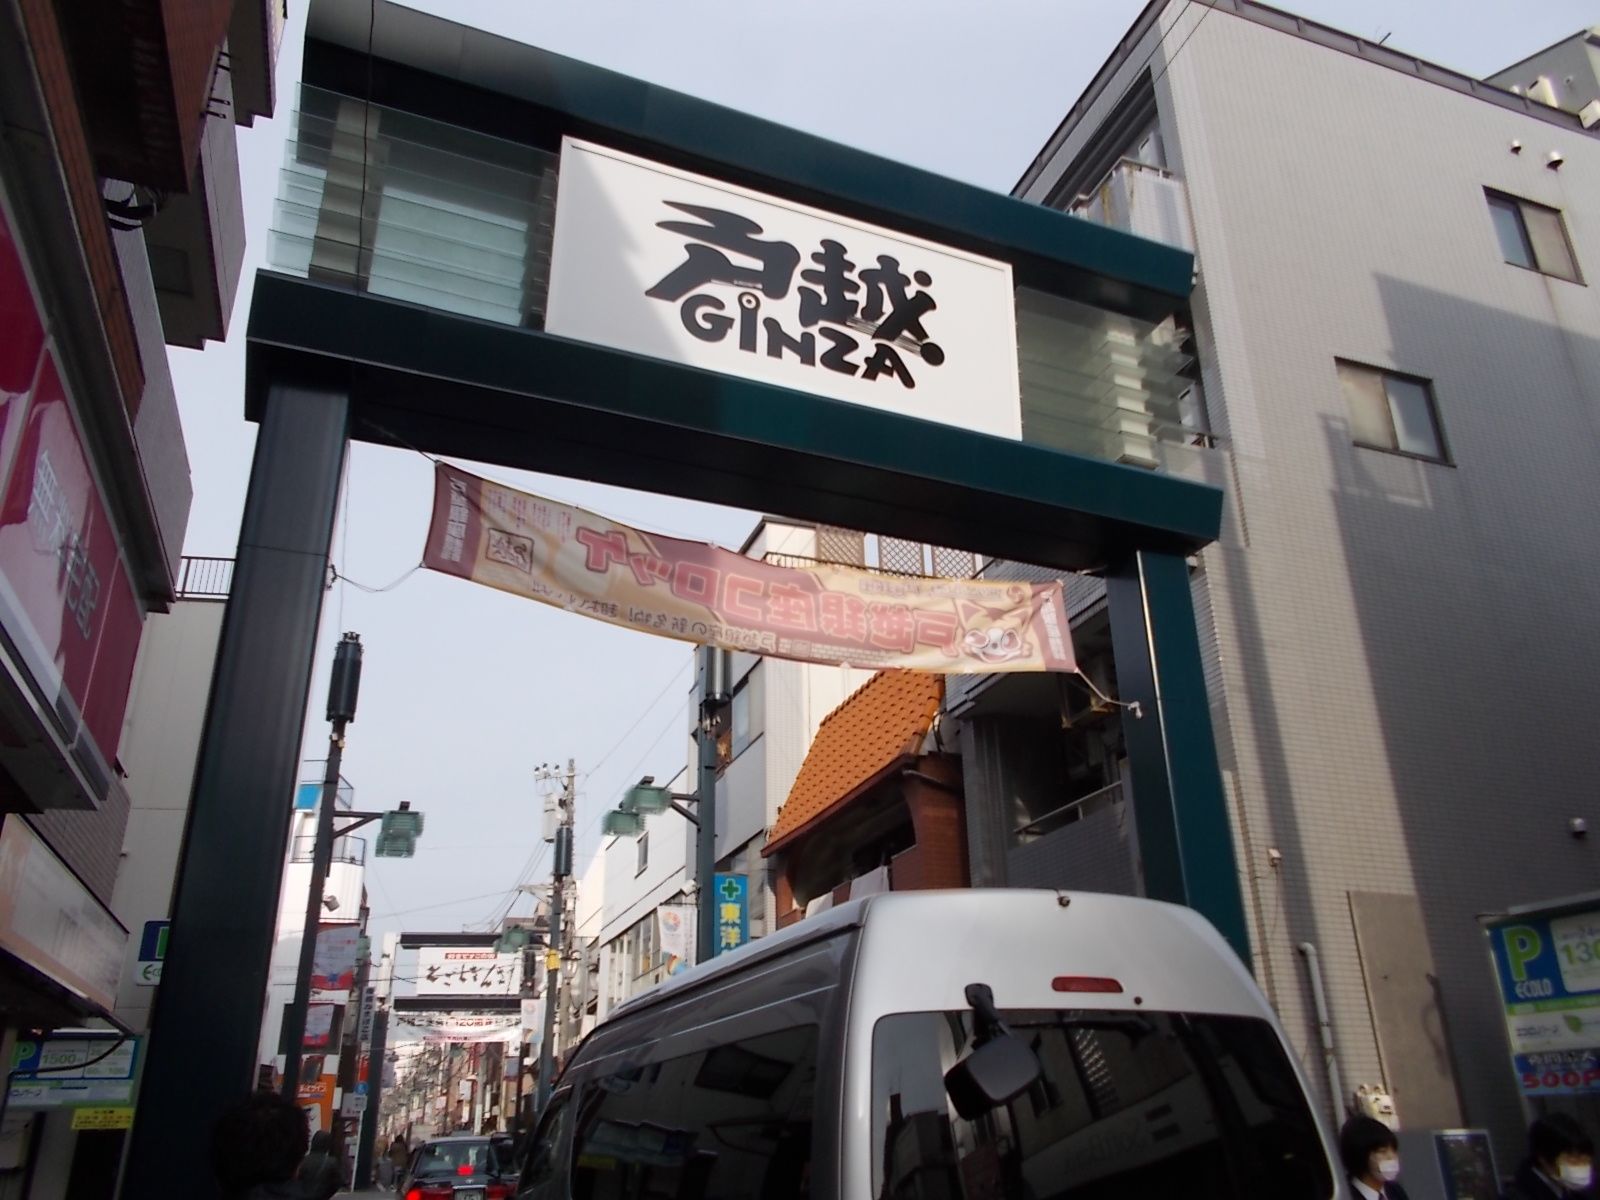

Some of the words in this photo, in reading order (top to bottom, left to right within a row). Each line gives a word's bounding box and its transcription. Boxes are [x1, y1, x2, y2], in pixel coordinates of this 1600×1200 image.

[680, 292, 916, 390] GINZA
[719, 903, 742, 956] 東洋
[1502, 925, 1543, 982] P
[1515, 978, 1553, 999] ECOLO
